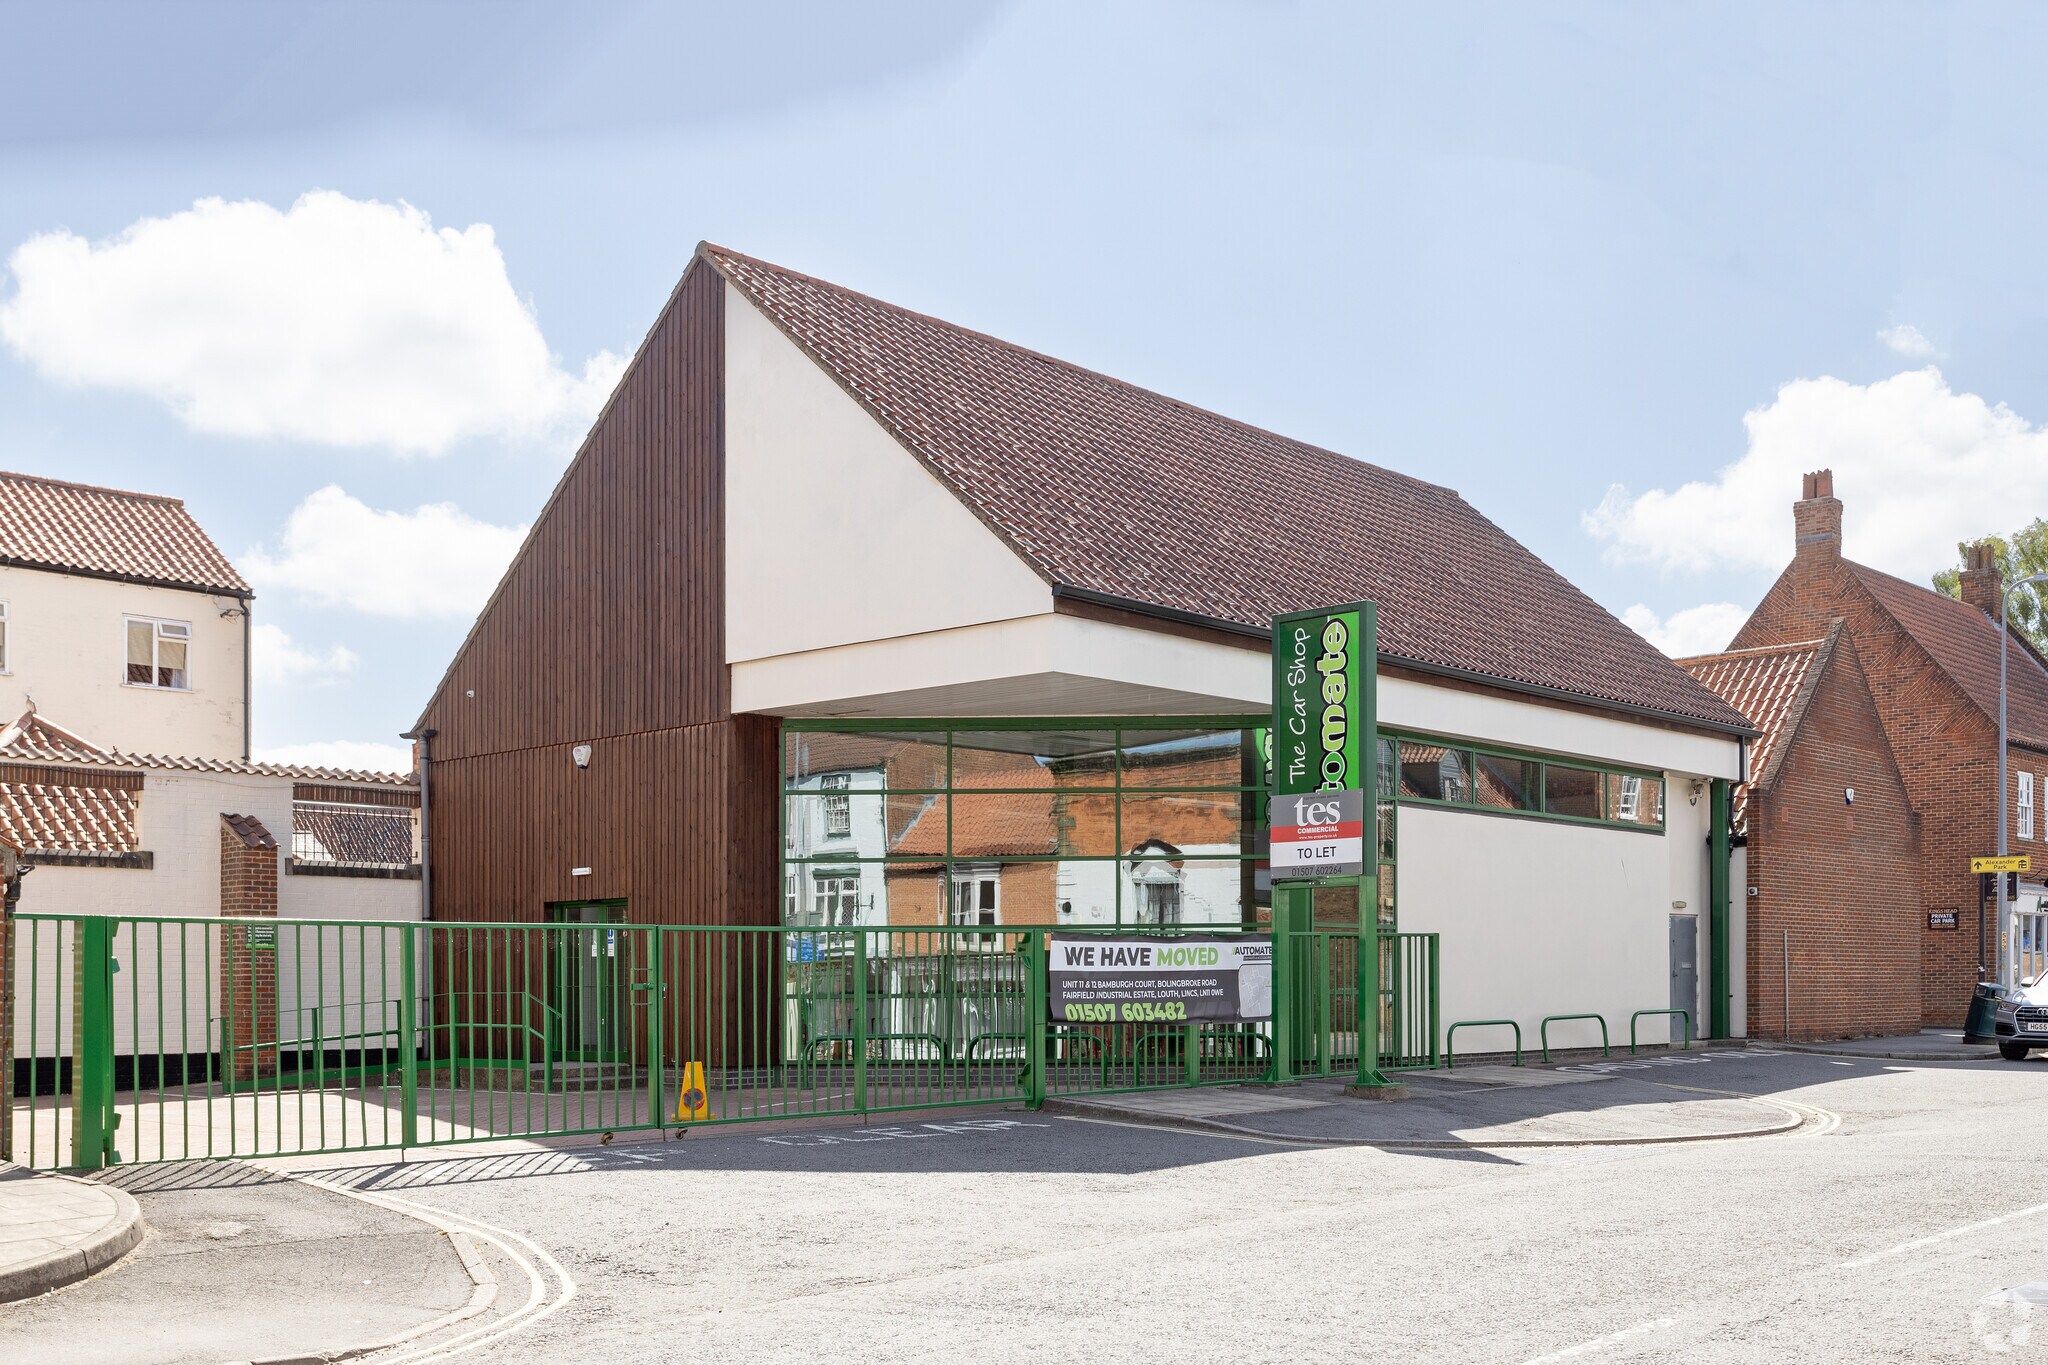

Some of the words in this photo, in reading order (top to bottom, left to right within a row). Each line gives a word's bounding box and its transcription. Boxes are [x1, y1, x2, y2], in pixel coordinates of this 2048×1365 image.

[1287, 627, 1311, 687] Shop
[1288, 690, 1306, 735] Car
[1289, 741, 1306, 785] The
[1293, 797, 1341, 827] tes
[1297, 825, 1339, 835] COMMERCIAL
[1297, 848, 1312, 859] TO
[1316, 846, 1337, 858] LET
[1291, 867, 1314, 877] 01507
[1315, 866, 1342, 876] 602264
[1064, 946, 1095, 966] WE
[1101, 947, 1151, 966] HAVE
[1156, 947, 1219, 967] MOVED
[1234, 946, 1272, 955] AUTOMATE
[1062, 980, 1077, 989] UNIT
[1078, 980, 1084, 988] 11
[1097, 980, 1134, 988] BAMBURGH
[1134, 980, 1157, 989] COURT,
[1157, 979, 1201, 988] BOLINGBROKE
[1201, 979, 1217, 987] ROAD
[1062, 991, 1095, 999] FAIRFIELD
[1096, 991, 1132, 999] INDUSTRIAL
[1133, 990, 1157, 1000] ESTATE,
[1157, 990, 1180, 998] LOUTH,
[1181, 989, 1199, 998] LINCS,
[1065, 1003, 1116, 1022] 01507
[1121, 1001, 1187, 1022] 603482
[757, 1119, 1051, 1146] CLEAR
